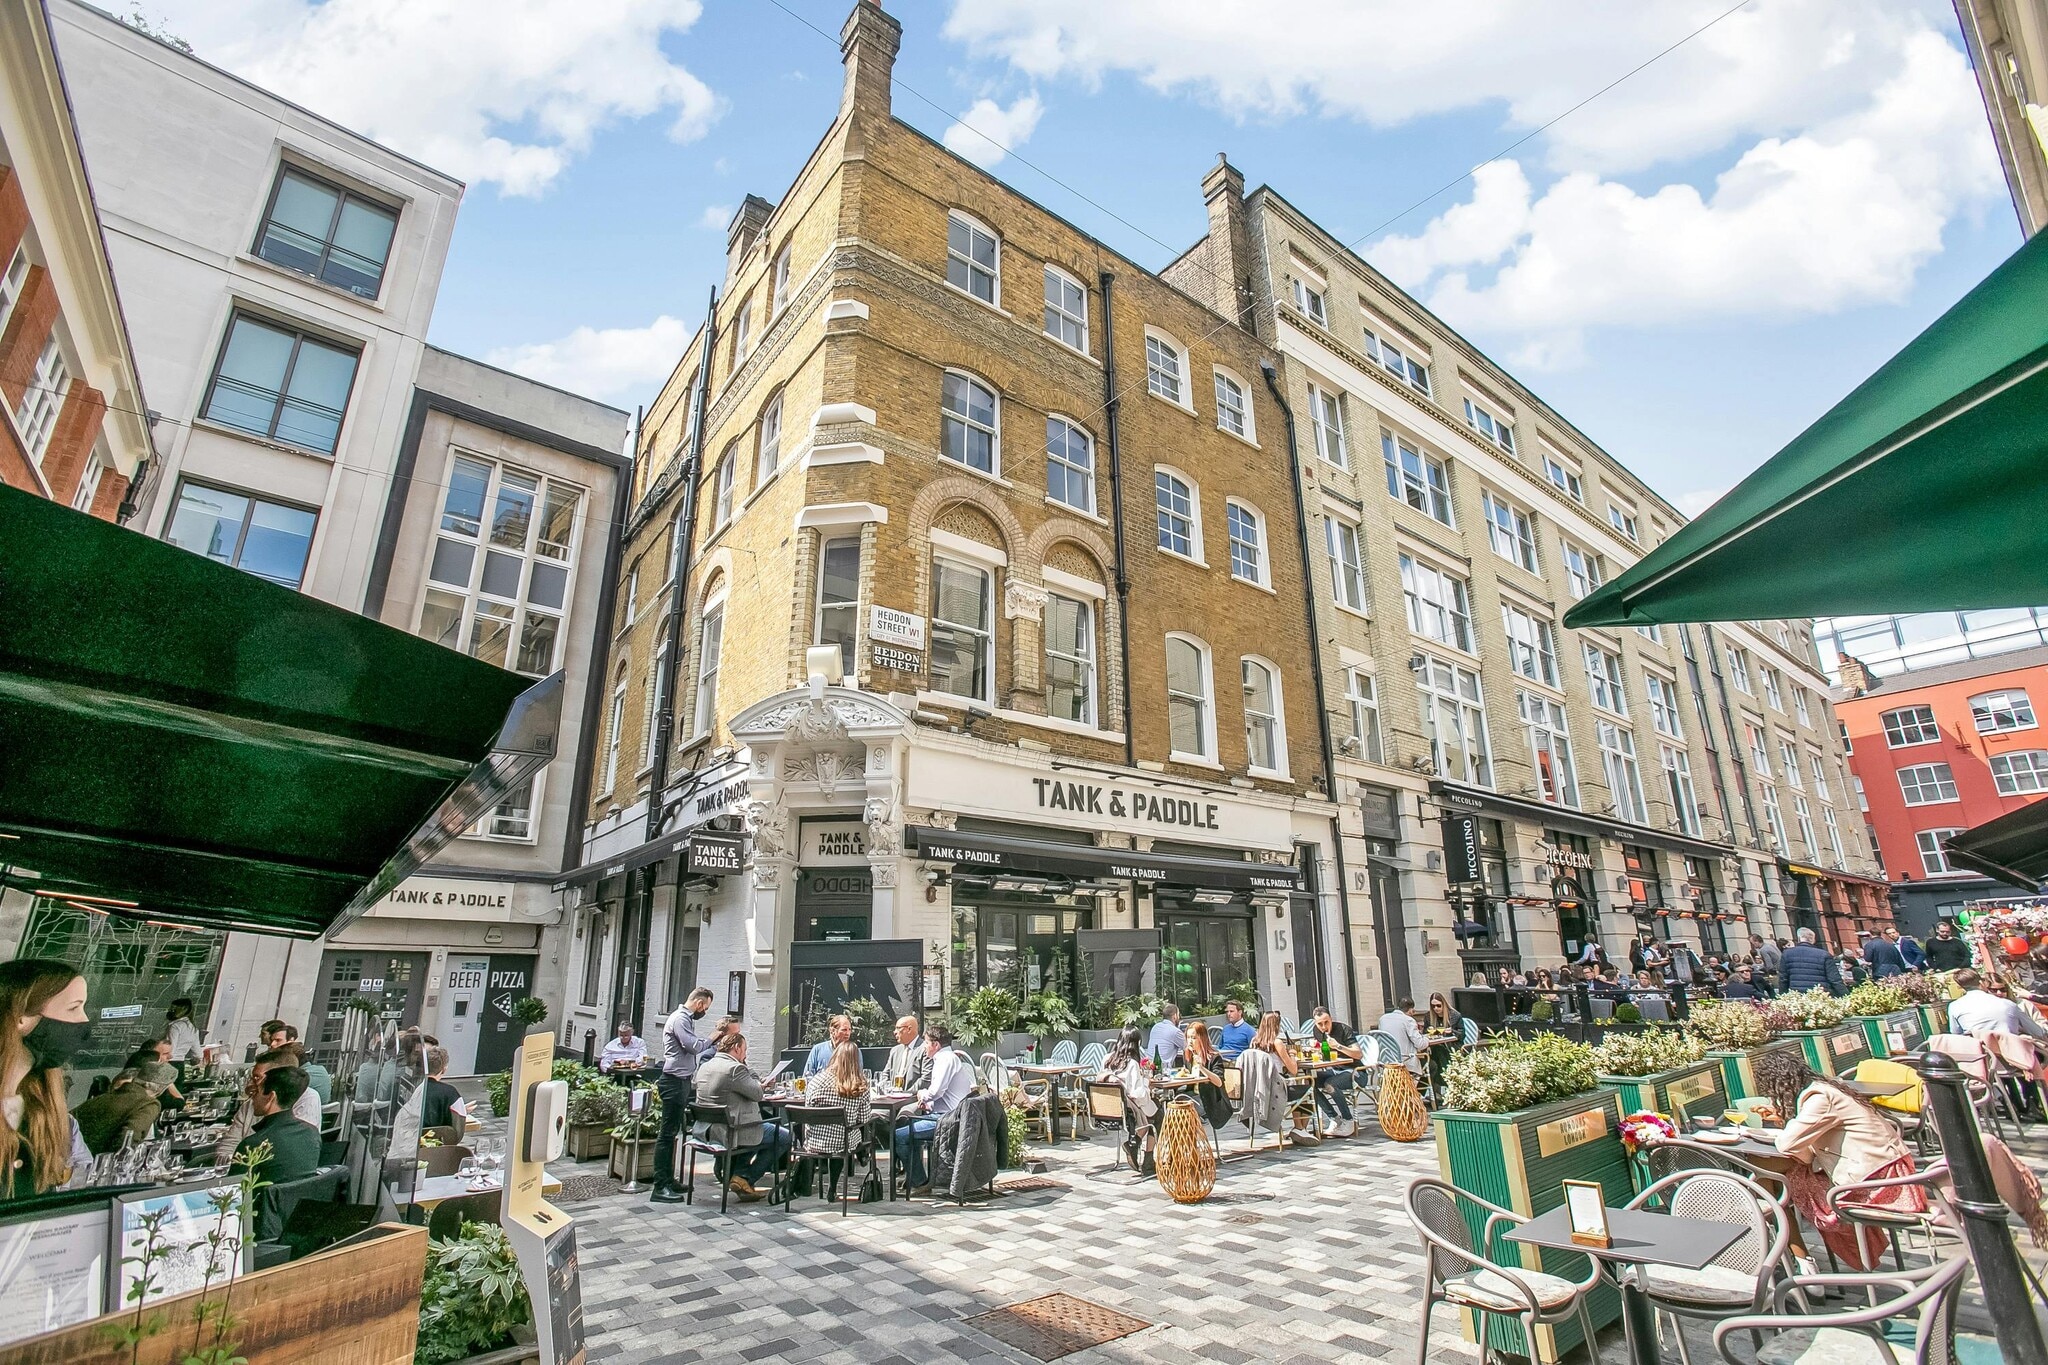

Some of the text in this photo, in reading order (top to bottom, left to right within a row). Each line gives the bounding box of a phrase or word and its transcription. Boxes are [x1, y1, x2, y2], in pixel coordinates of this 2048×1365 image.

[877, 609, 911, 625] HEDDON
[877, 620, 920, 638] STREET W1
[891, 636, 918, 647] WESTMINSTER
[874, 646, 920, 664] HEDDON
[874, 655, 920, 673] STREET
[696, 779, 750, 815] TANK & PADDL
[1032, 777, 1219, 829] TANK & PADDLE
[1451, 794, 1483, 808] PICCOLINO
[820, 832, 861, 844] TANK &
[695, 844, 736, 858] TANK &
[819, 844, 865, 855] PADDLE
[928, 846, 1001, 864] TANK & PADDLE
[1463, 819, 1478, 879] PICCOLINO
[694, 855, 740, 869] PADDLE
[1111, 866, 1166, 879] TANK & PADDLE
[1354, 871, 1365, 890] 19
[1249, 877, 1293, 888] TANK & PADDLE
[389, 890, 506, 908] TANK & PADDLE
[1274, 929, 1287, 951] 15
[229, 983, 235, 991] 5
[448, 971, 482, 989] BEER
[490, 971, 525, 989] PIZZA
[1563, 1129, 1587, 1146] LONDON
